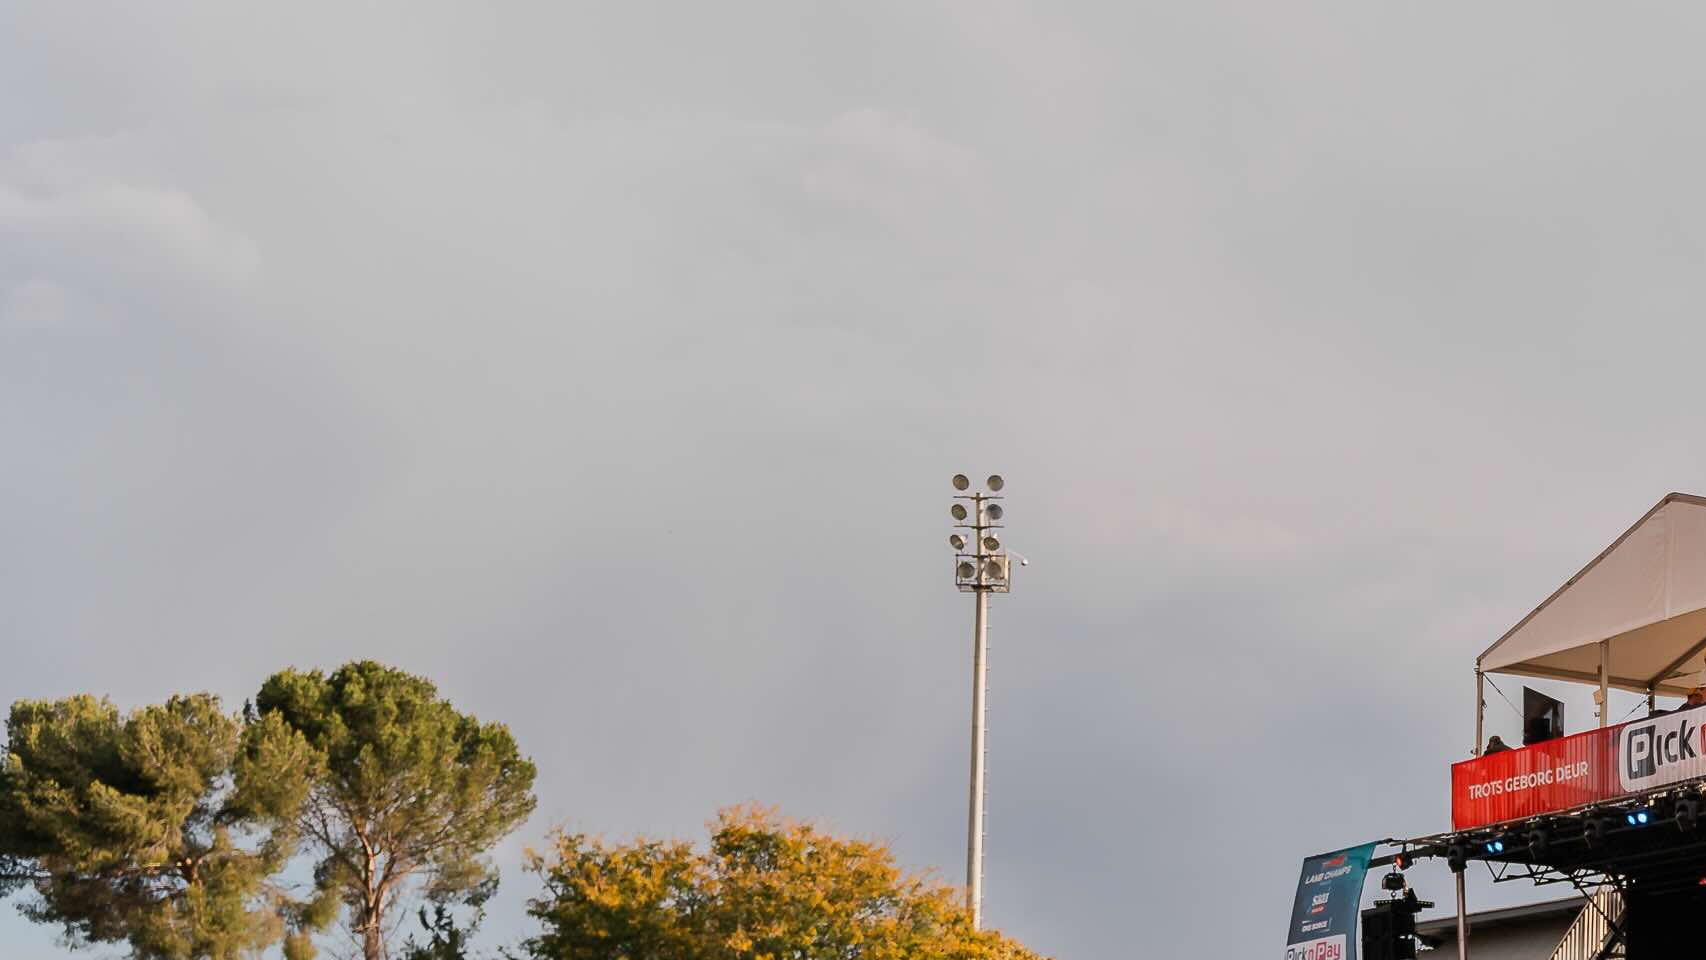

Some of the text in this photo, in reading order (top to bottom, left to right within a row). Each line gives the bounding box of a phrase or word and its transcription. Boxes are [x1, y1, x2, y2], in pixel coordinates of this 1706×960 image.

[1627, 719, 1697, 780] Pick
[1469, 761, 1588, 800] TROTS GEBORG DEUR
